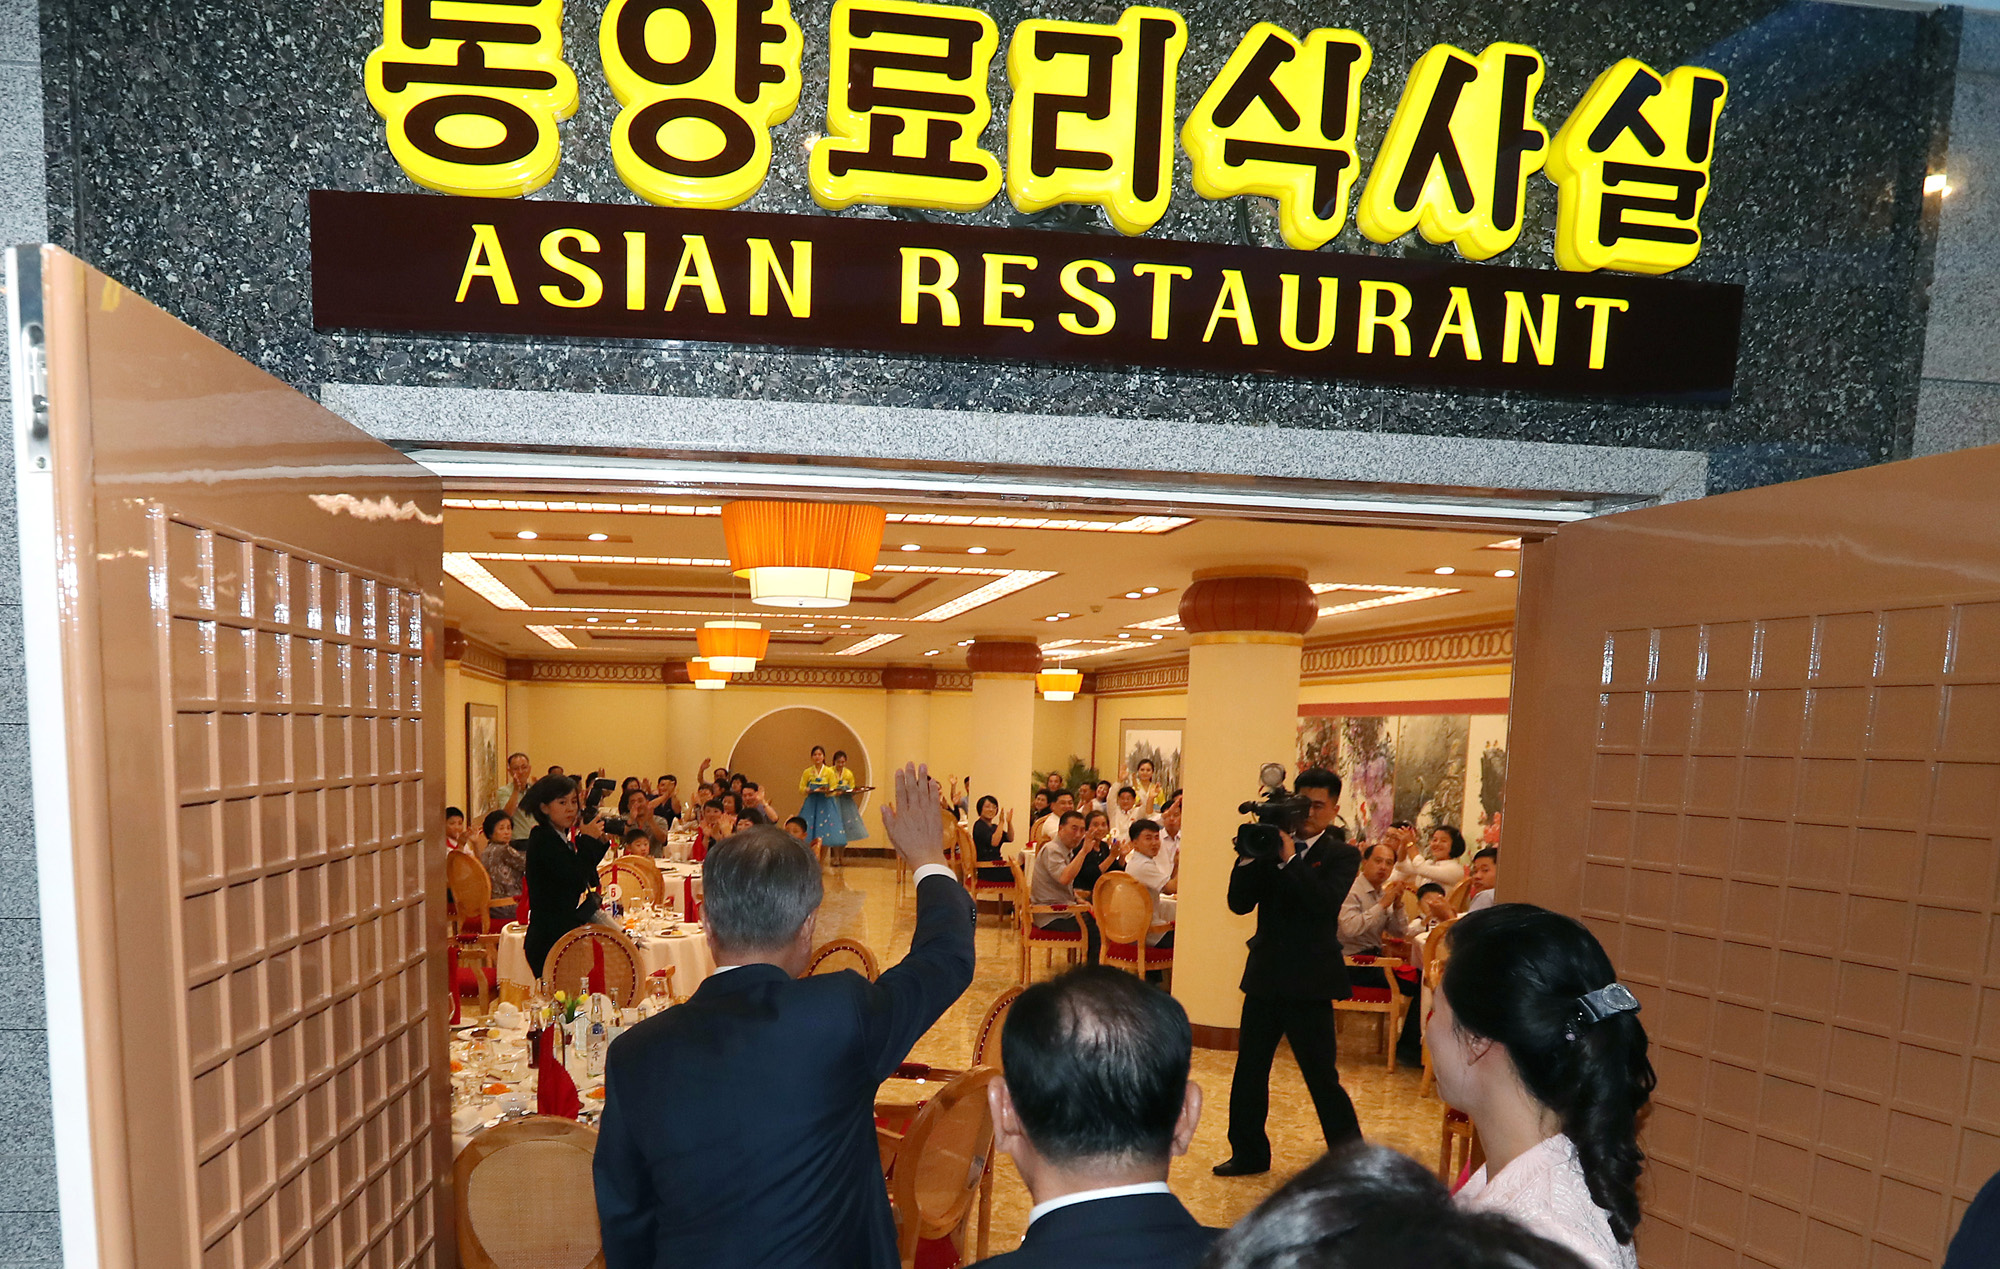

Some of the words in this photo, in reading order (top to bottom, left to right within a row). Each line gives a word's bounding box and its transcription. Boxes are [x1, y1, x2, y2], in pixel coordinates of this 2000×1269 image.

[368, 0, 1727, 264] 동양료리식사실
[455, 224, 813, 318] ASIAN
[899, 247, 1630, 370] RESTAURANT
